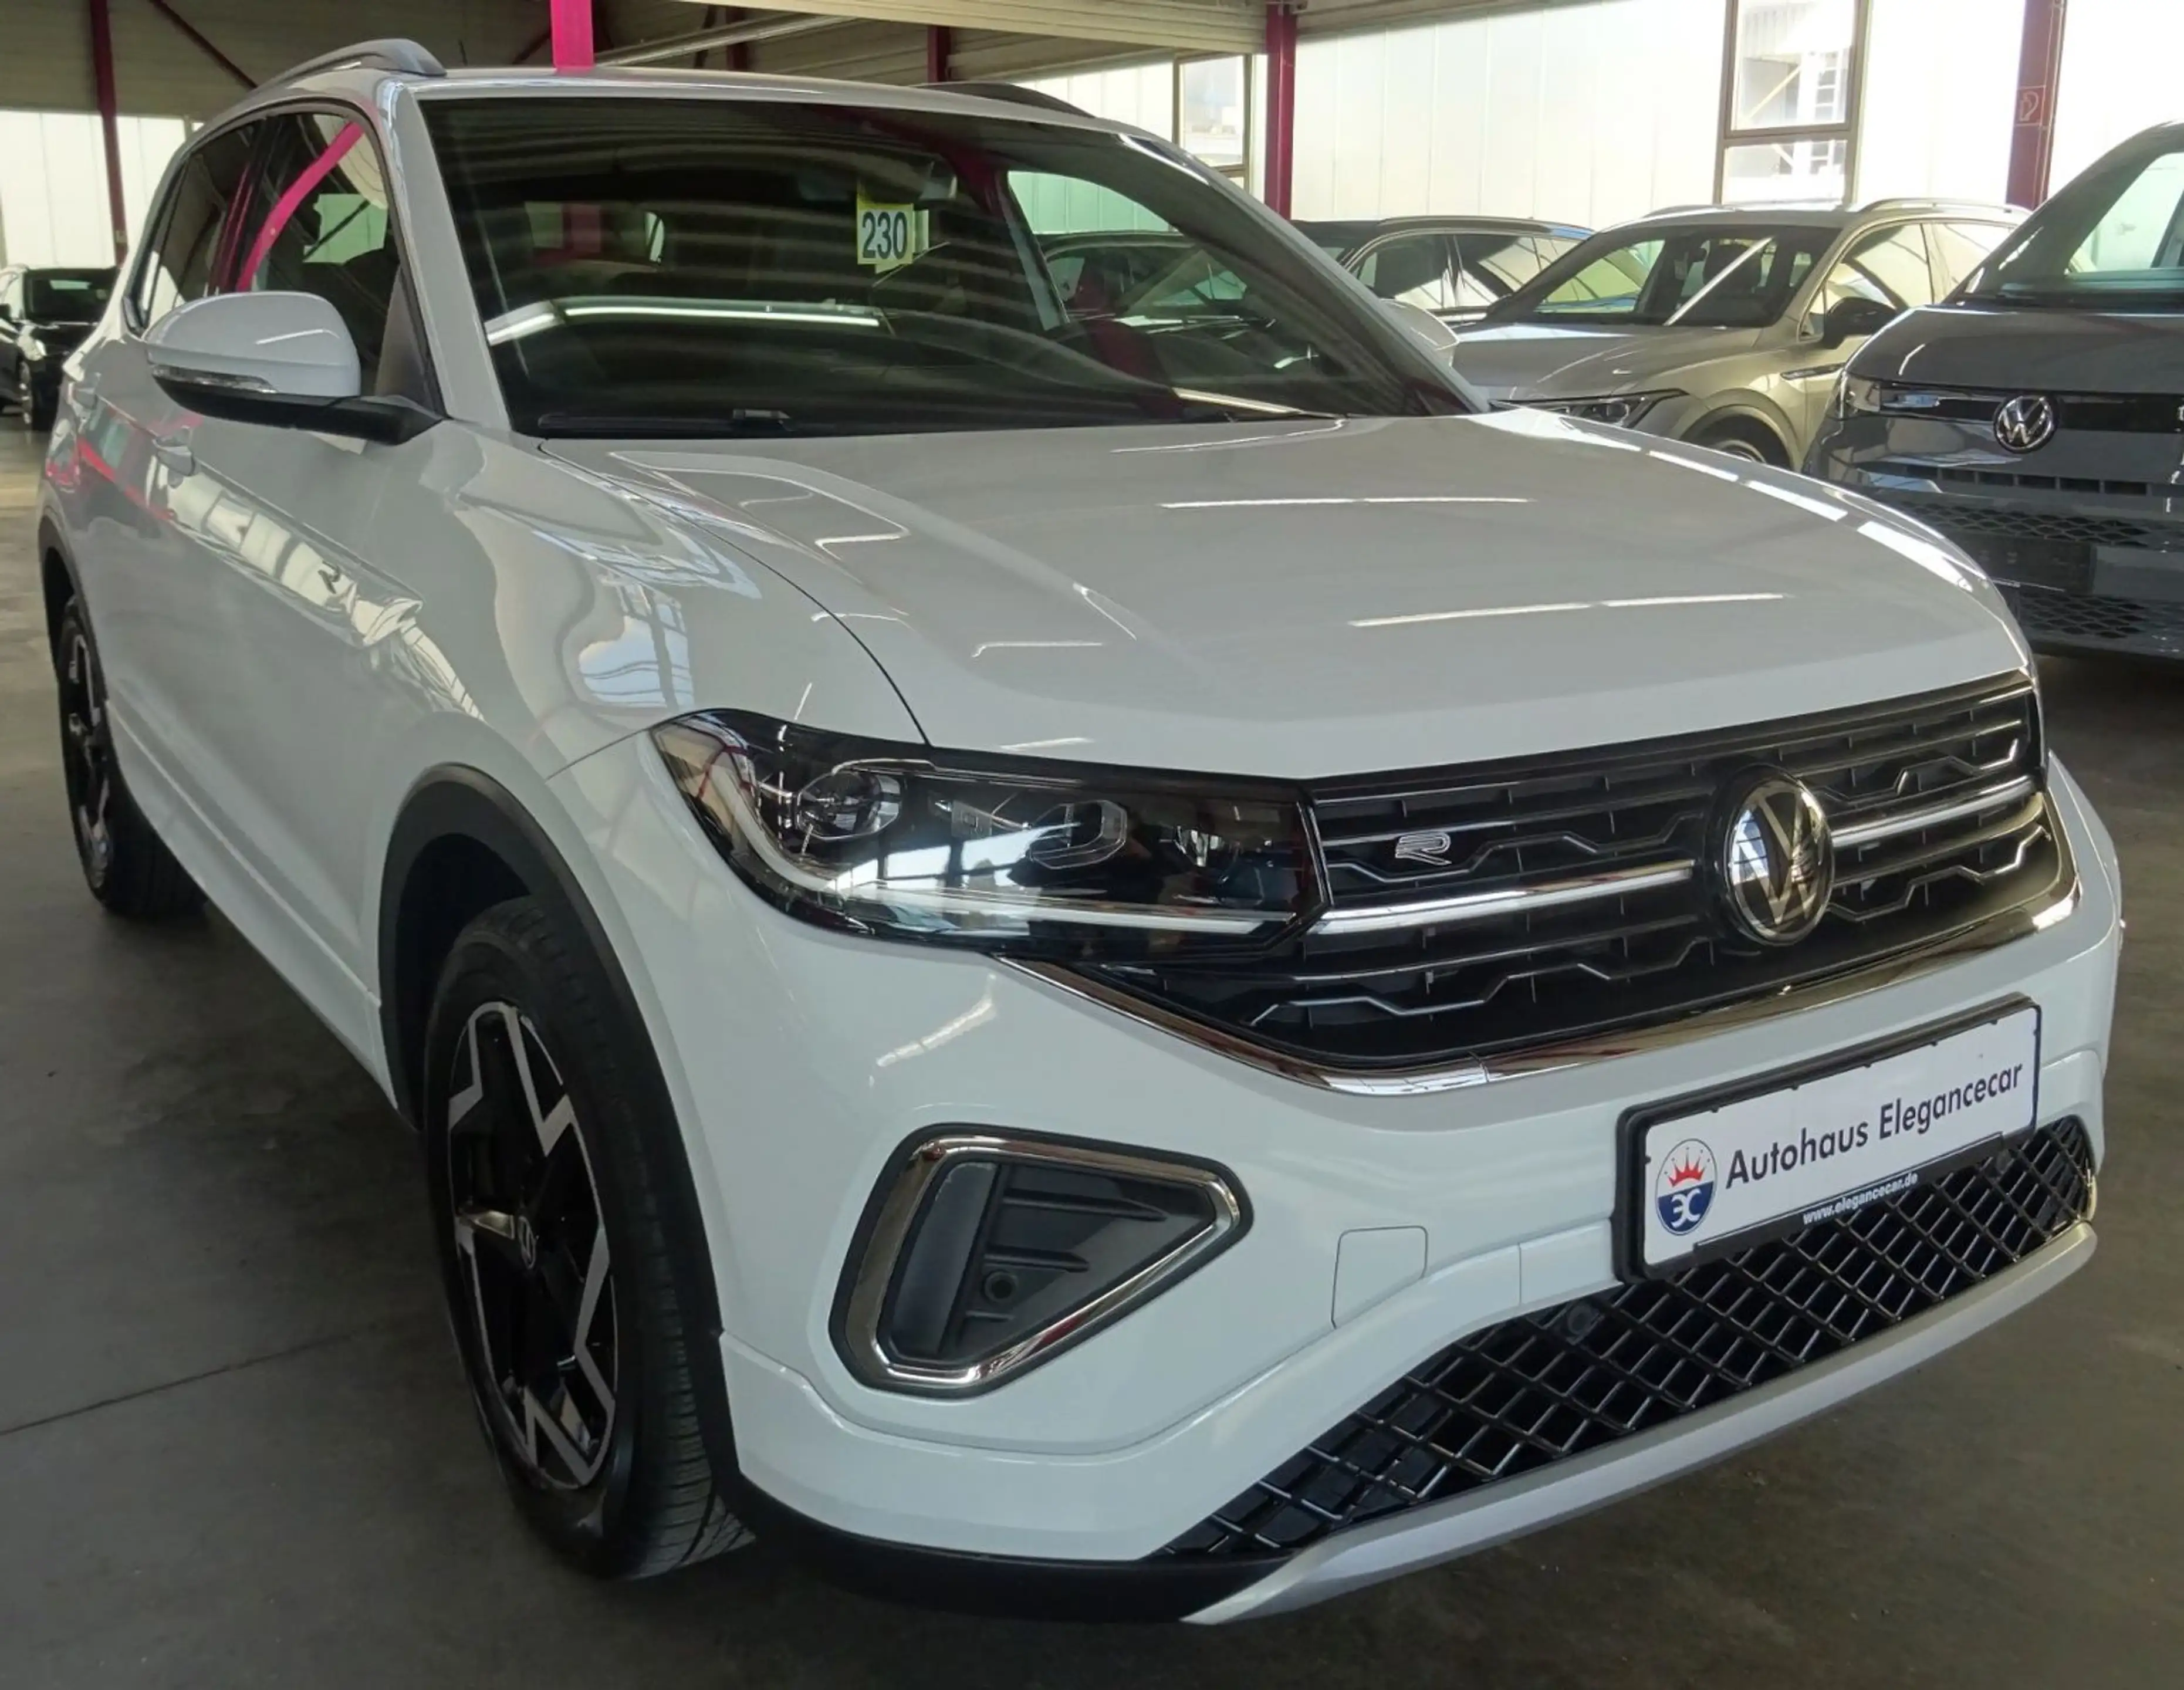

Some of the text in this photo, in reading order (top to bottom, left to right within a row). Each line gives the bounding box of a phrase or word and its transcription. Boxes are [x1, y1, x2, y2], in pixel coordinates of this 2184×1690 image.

[863, 211, 908, 259] 230
[1993, 396, 2054, 449] VW
[1394, 832, 1453, 866] R
[1725, 1063, 2023, 1189] Autohaus Elegancecar
[1802, 1172, 1919, 1225] www.elegancecar.de
